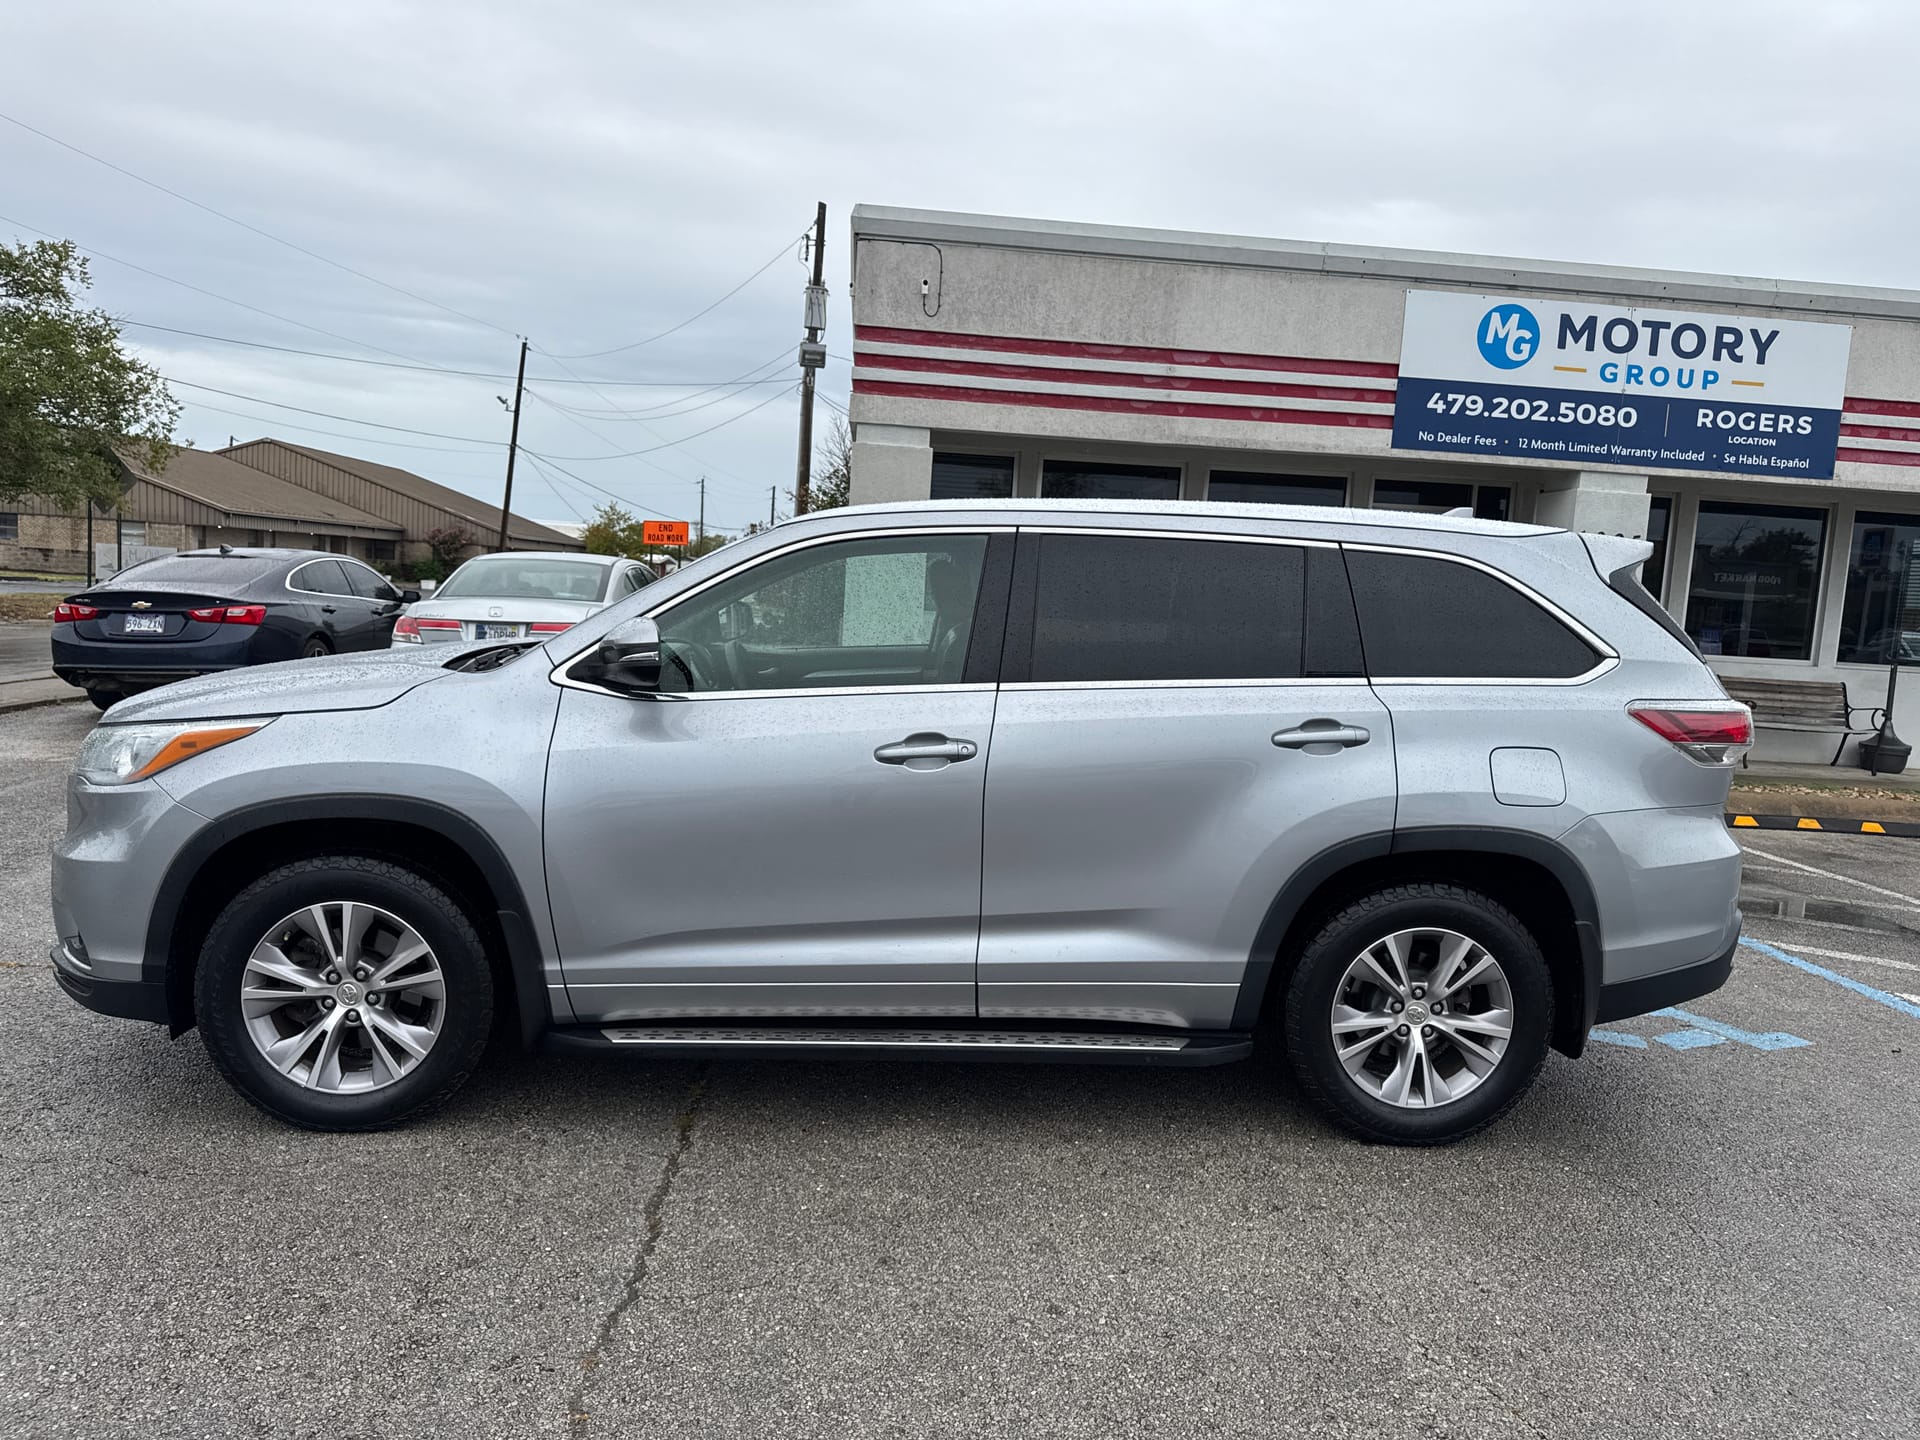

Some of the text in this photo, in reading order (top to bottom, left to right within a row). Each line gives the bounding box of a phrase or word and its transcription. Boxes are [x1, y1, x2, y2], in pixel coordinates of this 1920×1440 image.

[1485, 312, 1533, 362] MG
[1557, 313, 1780, 365] MOTORY
[1599, 362, 1720, 390] GROUP
[1426, 392, 1638, 428] 479.202.5080
[1696, 408, 1813, 435] ROGERS
[1418, 430, 1810, 470] No Dealer Fees 12 Month Limited Warranty Included Se Habla Español
[1728, 435, 1777, 447] LOCATION
[647, 533, 684, 543] ROAD WORK
[658, 523, 674, 533] END
[127, 619, 142, 629] 596
